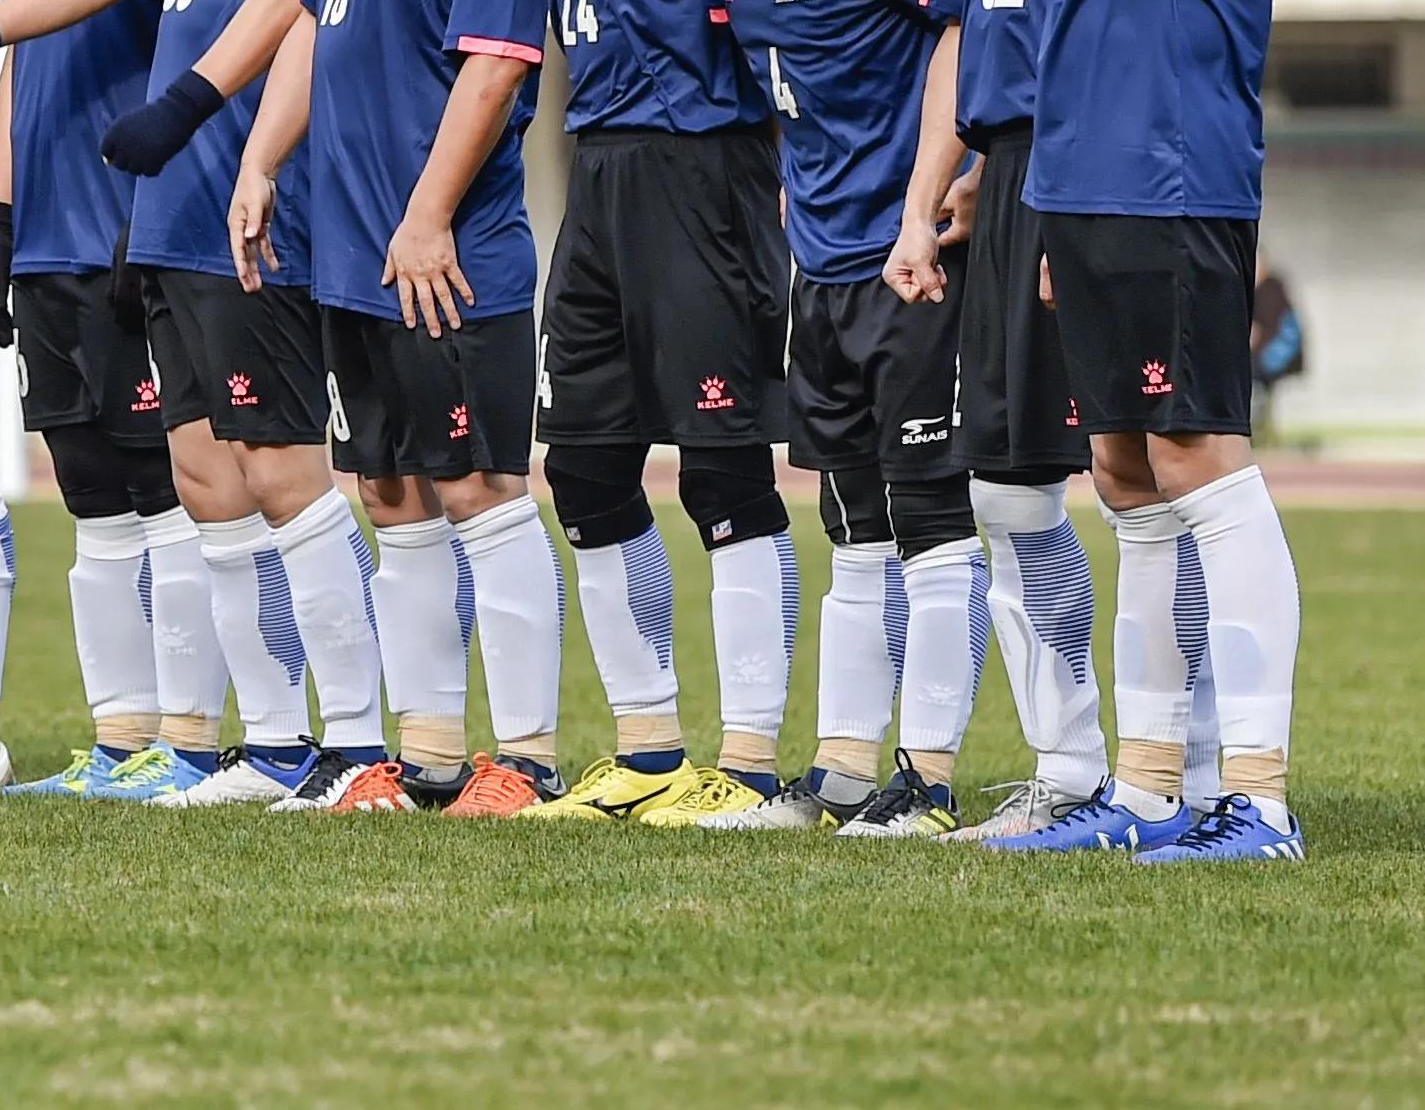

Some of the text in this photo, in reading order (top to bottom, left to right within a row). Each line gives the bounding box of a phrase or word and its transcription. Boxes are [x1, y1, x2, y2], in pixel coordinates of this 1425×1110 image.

[768, 46, 800, 119] 4
[696, 398, 735, 410] KELME
[901, 429, 948, 445] SUNAIS
